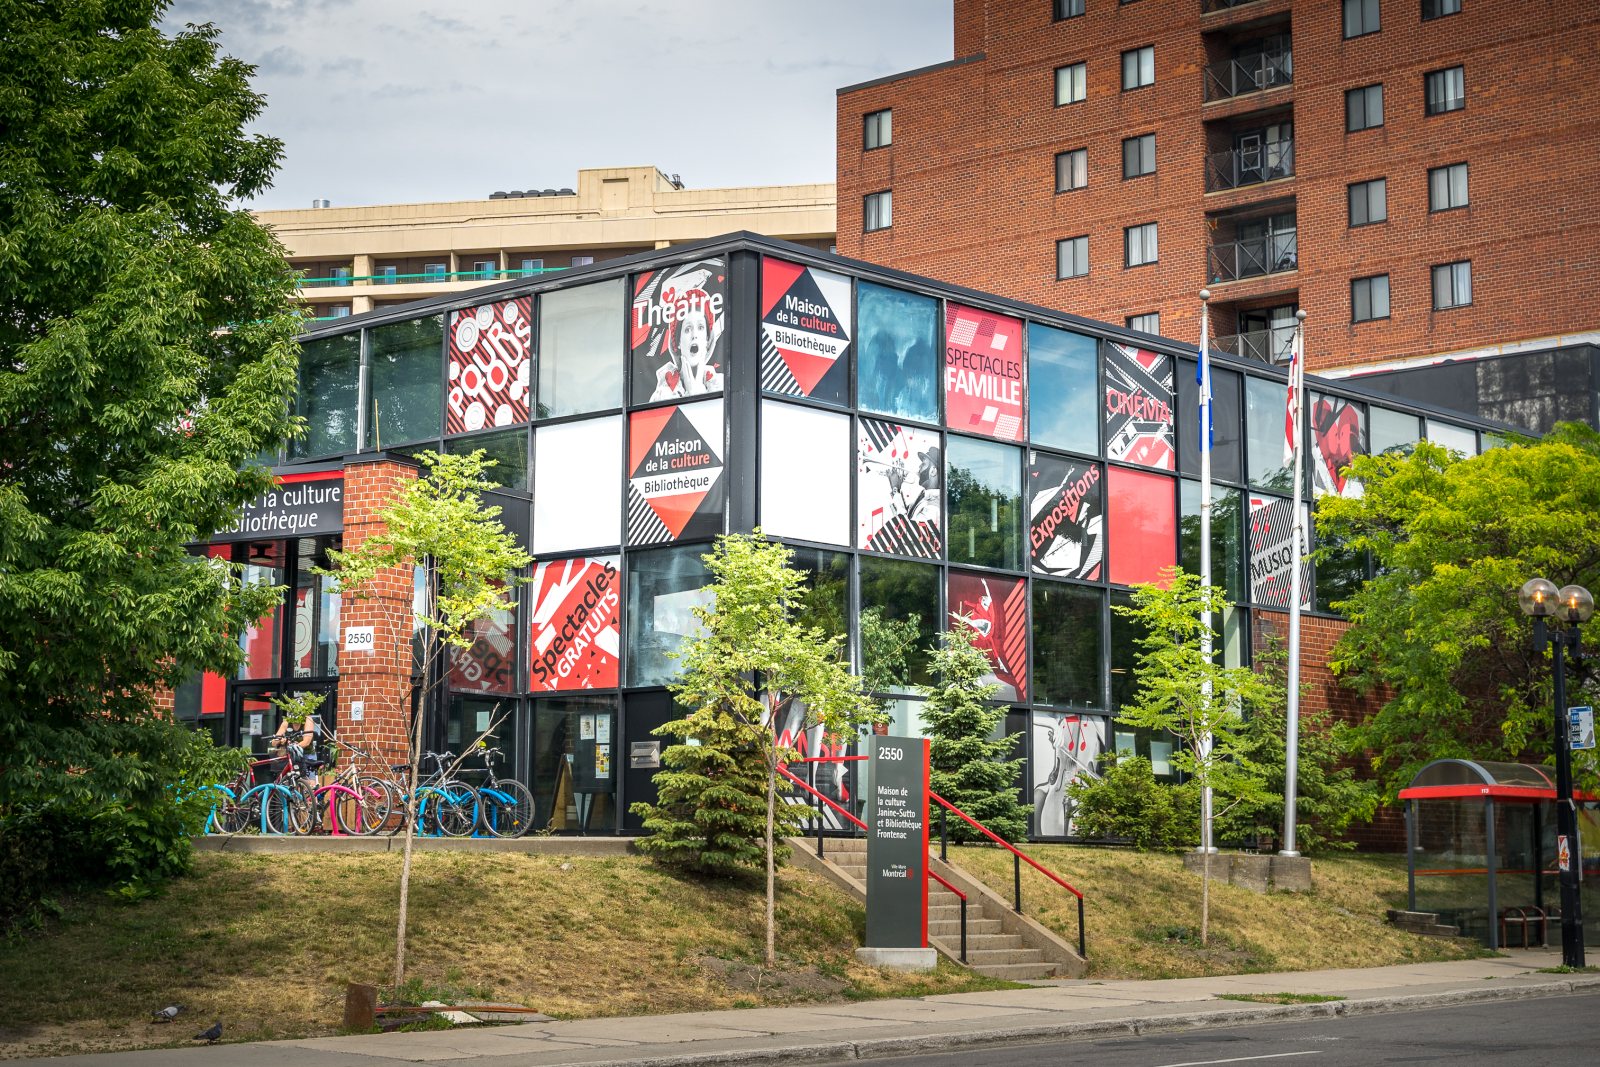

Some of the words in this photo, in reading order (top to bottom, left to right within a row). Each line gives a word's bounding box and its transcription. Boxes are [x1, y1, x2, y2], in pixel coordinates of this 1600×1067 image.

[785, 294, 829, 319] Maison
[776, 310, 789, 323] de
[790, 312, 799, 326] la
[800, 316, 837, 334] culture
[775, 330, 837, 355] Bibliothèque
[449, 321, 511, 418] POUR
[472, 317, 531, 408] TOUS
[946, 347, 1020, 380] SPECTACLES
[947, 367, 1020, 406] FAMILLE
[1107, 389, 1171, 424] CINÉMA
[655, 438, 701, 457] Maison
[645, 459, 657, 472] de
[659, 458, 668, 470] la
[671, 452, 710, 469] culture
[283, 484, 341, 506] culture
[644, 475, 709, 494] Bibliothèque
[1030, 464, 1100, 549] Expositions
[1251, 538, 1307, 581] MUSIQE
[532, 560, 617, 683] Spectacles
[557, 588, 619, 678] GRATUITS
[348, 632, 372, 644] 2550
[878, 746, 903, 761] 2550
[877, 786, 899, 796] Maison
[900, 787, 908, 797] de
[877, 796, 883, 806] la
[884, 797, 906, 807] culture
[877, 808, 915, 818] Janine-Sutto
[877, 819, 884, 828] et
[885, 818, 922, 831] Bibliothèque
[877, 829, 907, 839] Frontenac
[882, 869, 907, 878] Montréal
